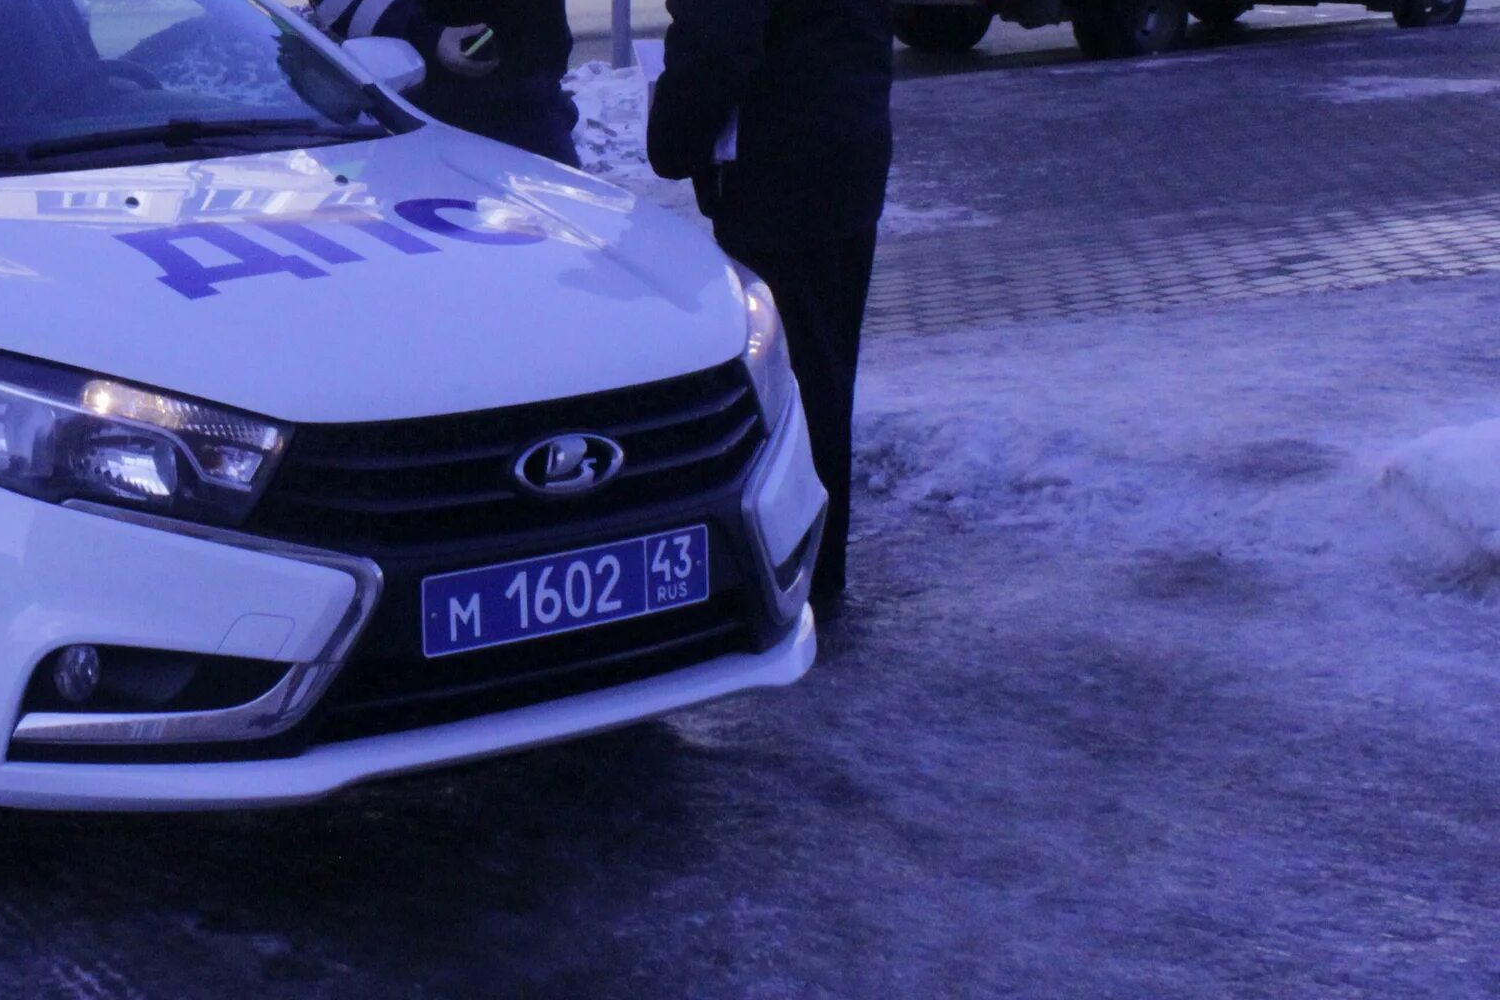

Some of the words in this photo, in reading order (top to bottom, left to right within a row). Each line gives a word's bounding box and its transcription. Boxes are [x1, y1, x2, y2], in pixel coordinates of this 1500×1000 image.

[112, 198, 548, 300] ДПС
[505, 555, 622, 629] 1602
[651, 535, 692, 582] 43
[657, 581, 688, 602] RUS
